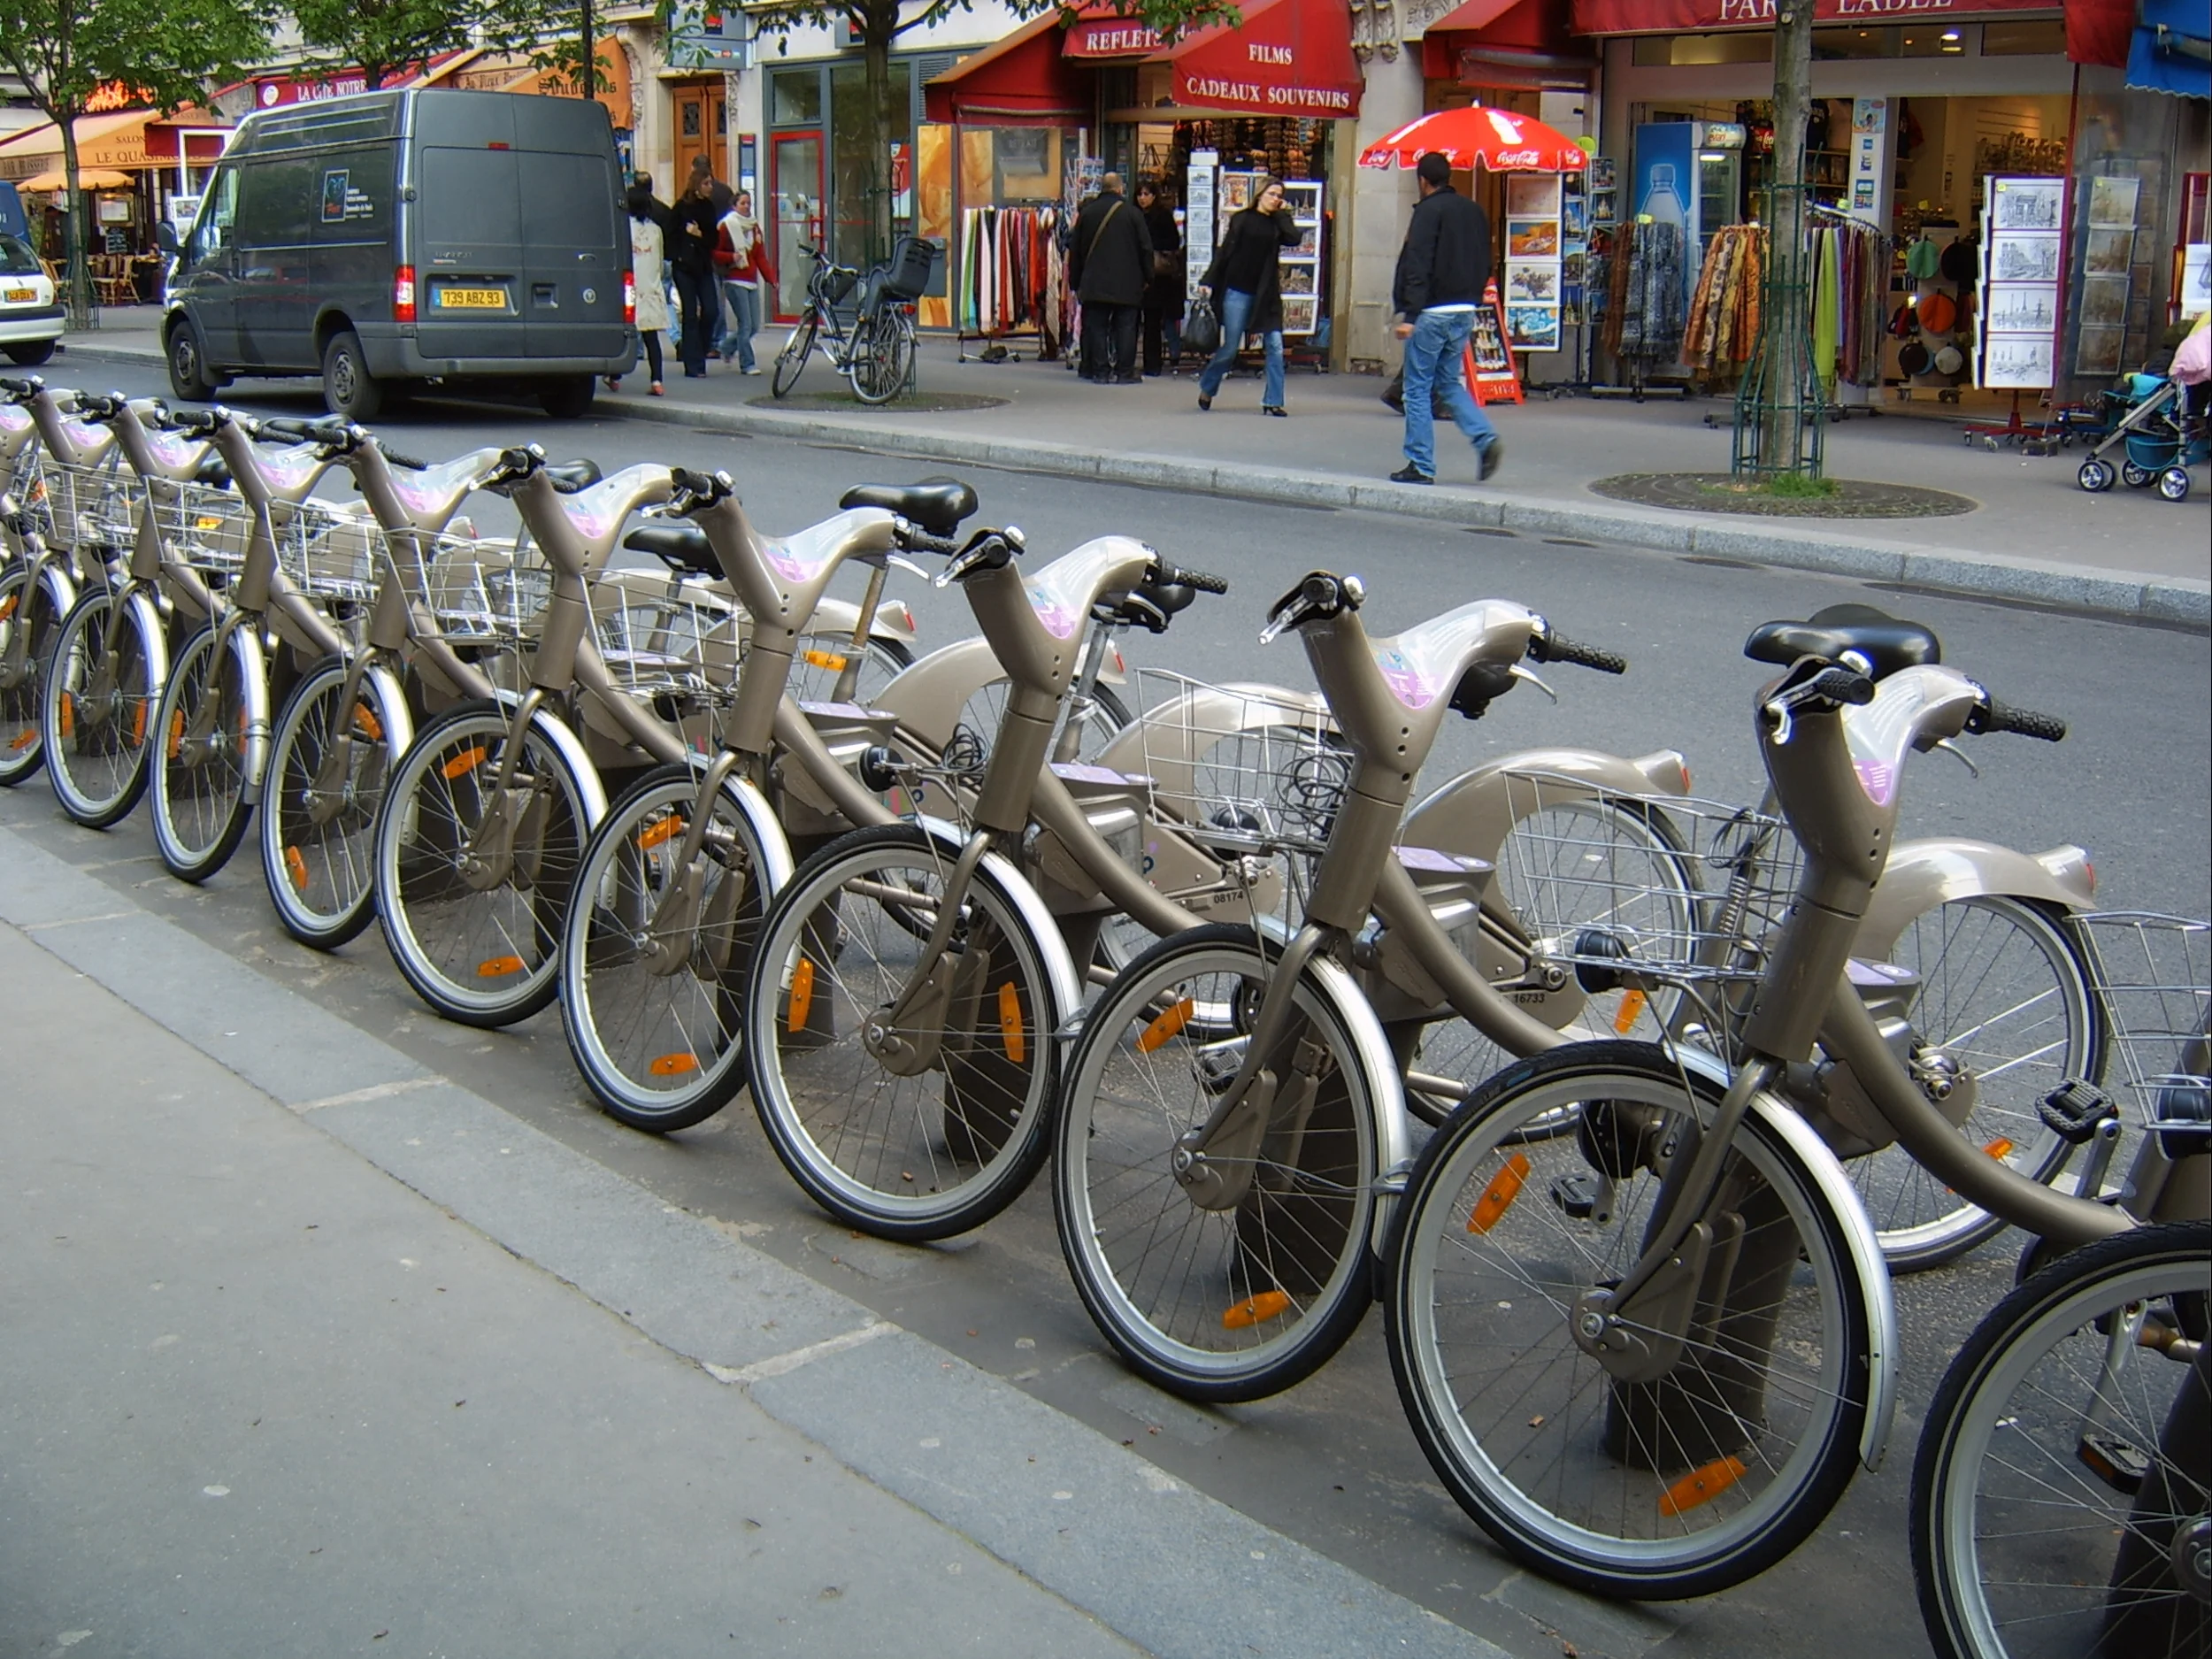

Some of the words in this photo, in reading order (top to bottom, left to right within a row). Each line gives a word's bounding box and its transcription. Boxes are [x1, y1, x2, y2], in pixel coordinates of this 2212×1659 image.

[1248, 43, 1293, 65] FILMS
[296, 85, 311, 102] LA
[336, 79, 368, 97] NOTRE
[1187, 77, 1261, 103] CADEAUX
[1268, 87, 1350, 109] SOUVENIRS
[96, 152, 112, 164] LE
[443, 291, 464, 304] 739
[466, 291, 485, 304] ABZ
[487, 291, 500, 304] 93
[1213, 890, 1244, 903] 08174
